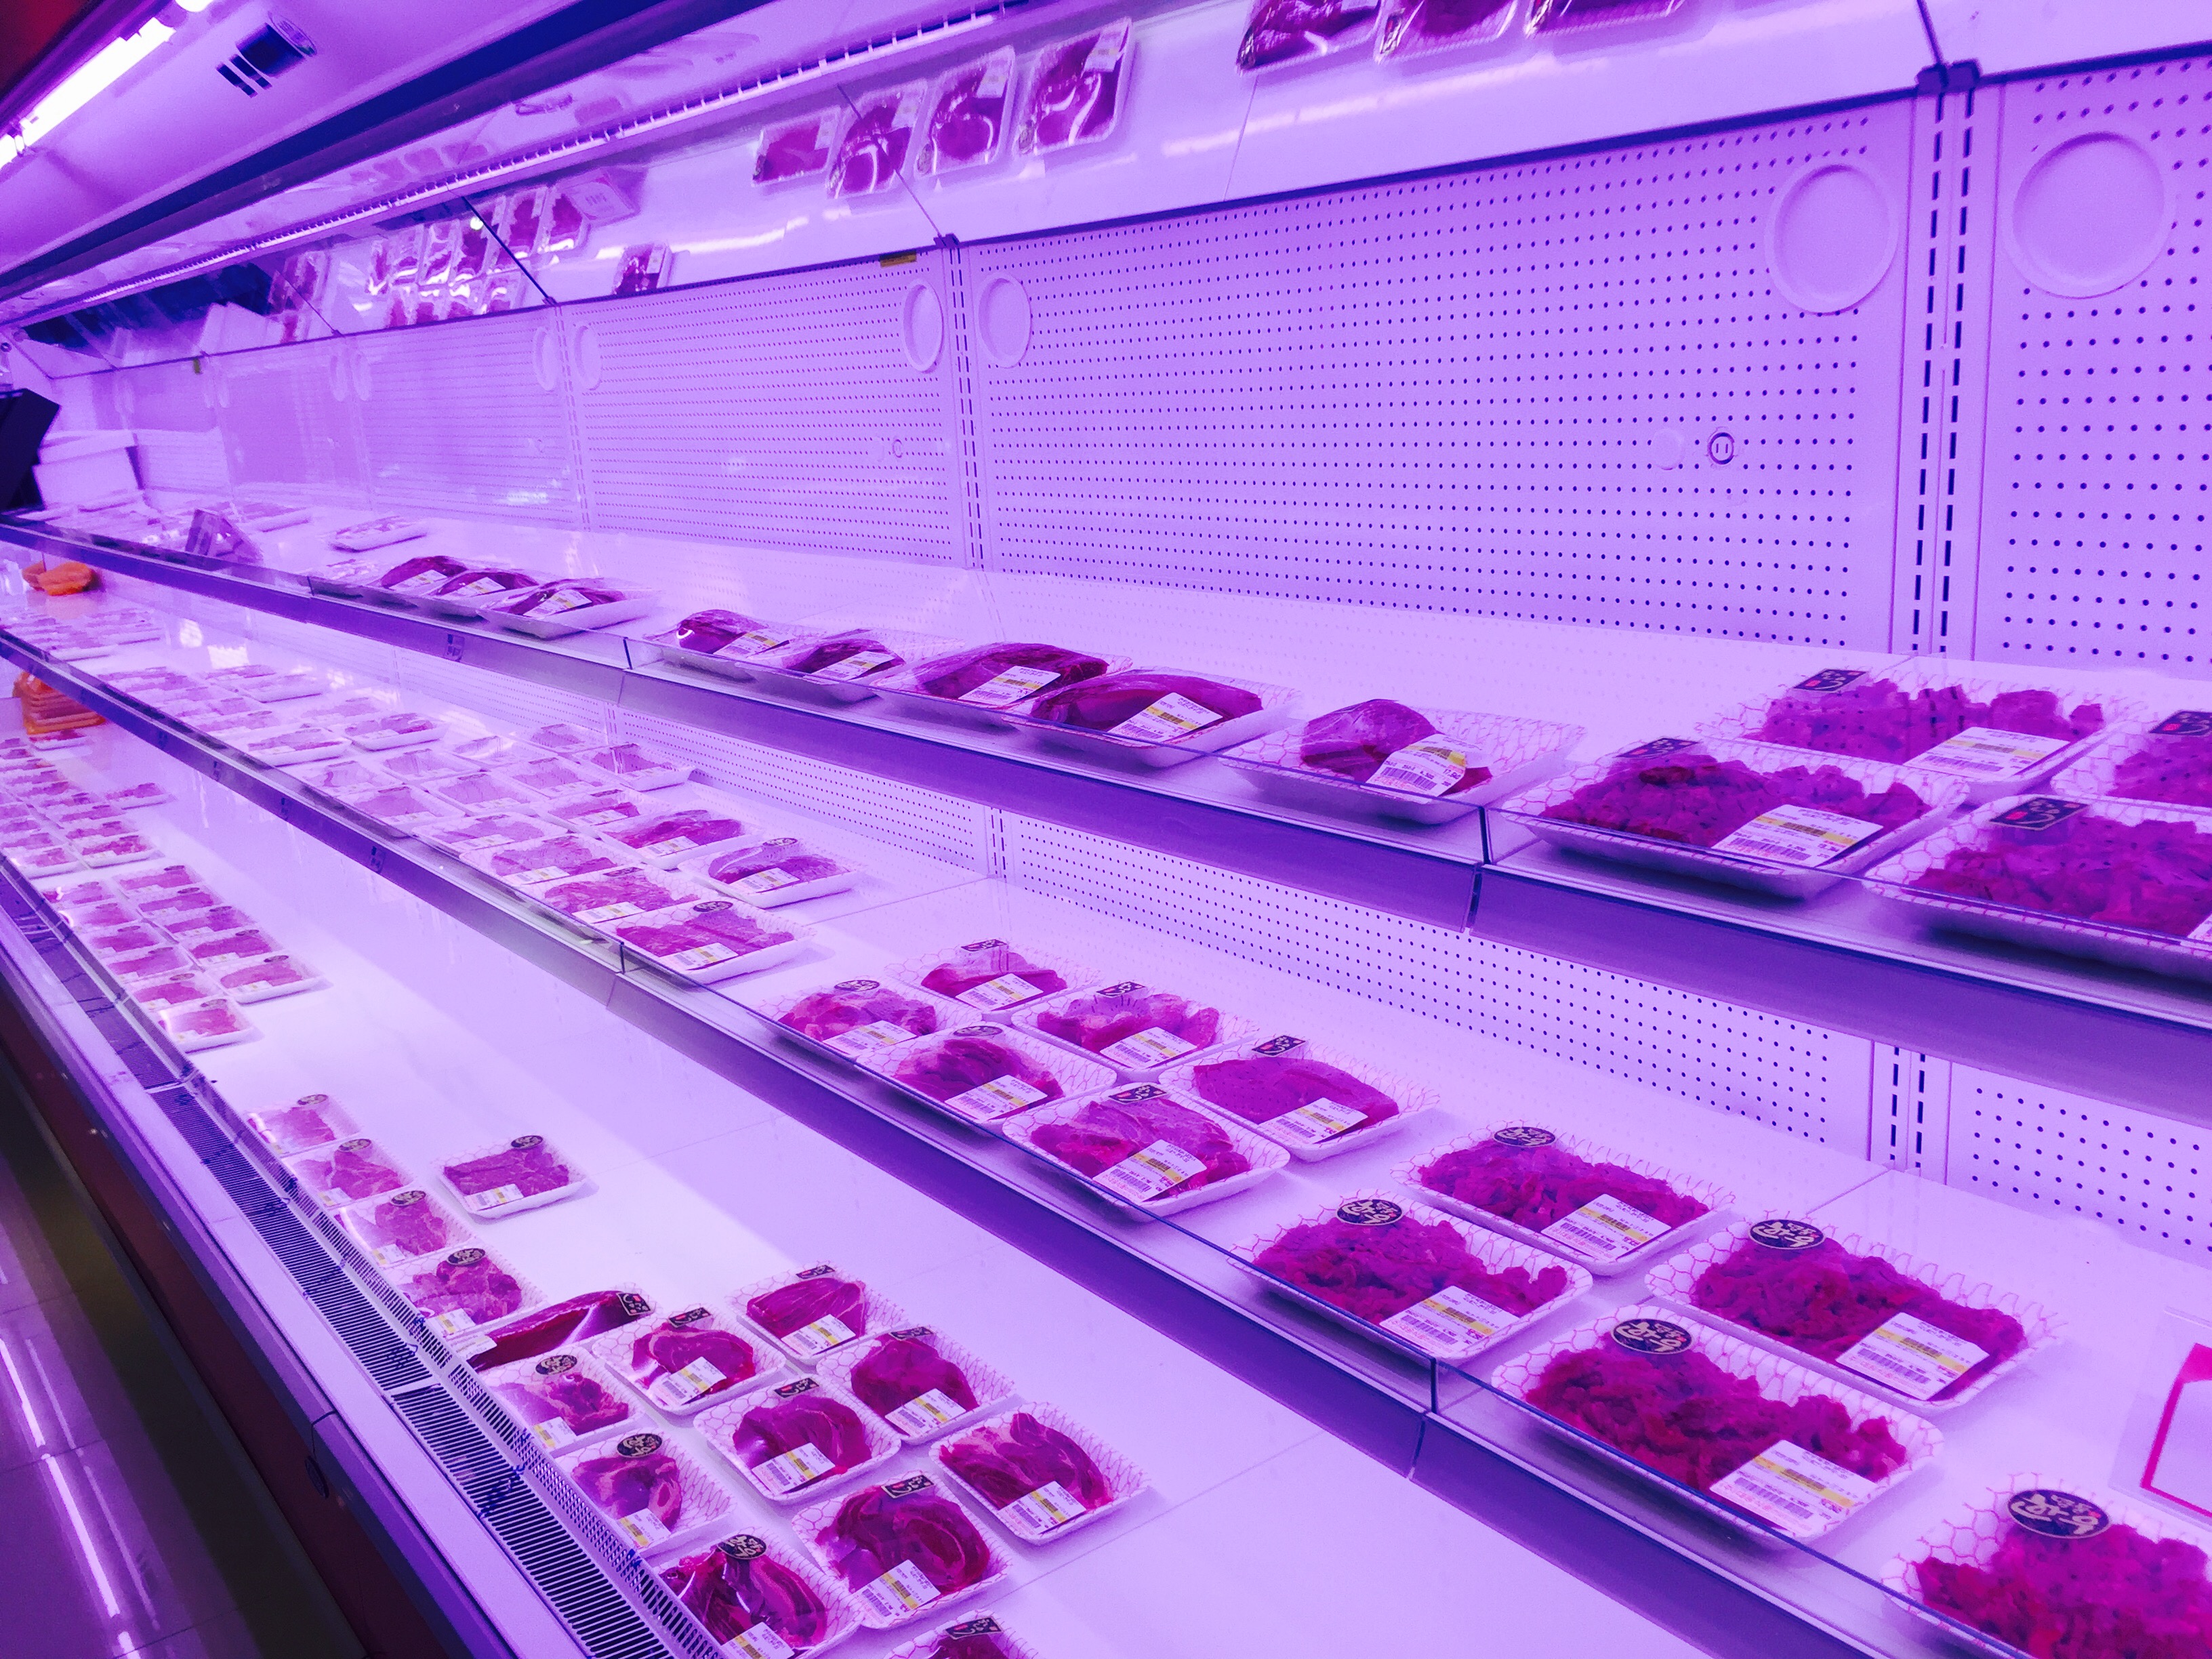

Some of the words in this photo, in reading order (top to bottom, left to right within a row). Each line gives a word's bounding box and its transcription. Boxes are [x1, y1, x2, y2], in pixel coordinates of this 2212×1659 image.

[1752, 1221, 1815, 1248] 한우
[1615, 1322, 1682, 1352] 한우
[2010, 1493, 2099, 1535] 한우
